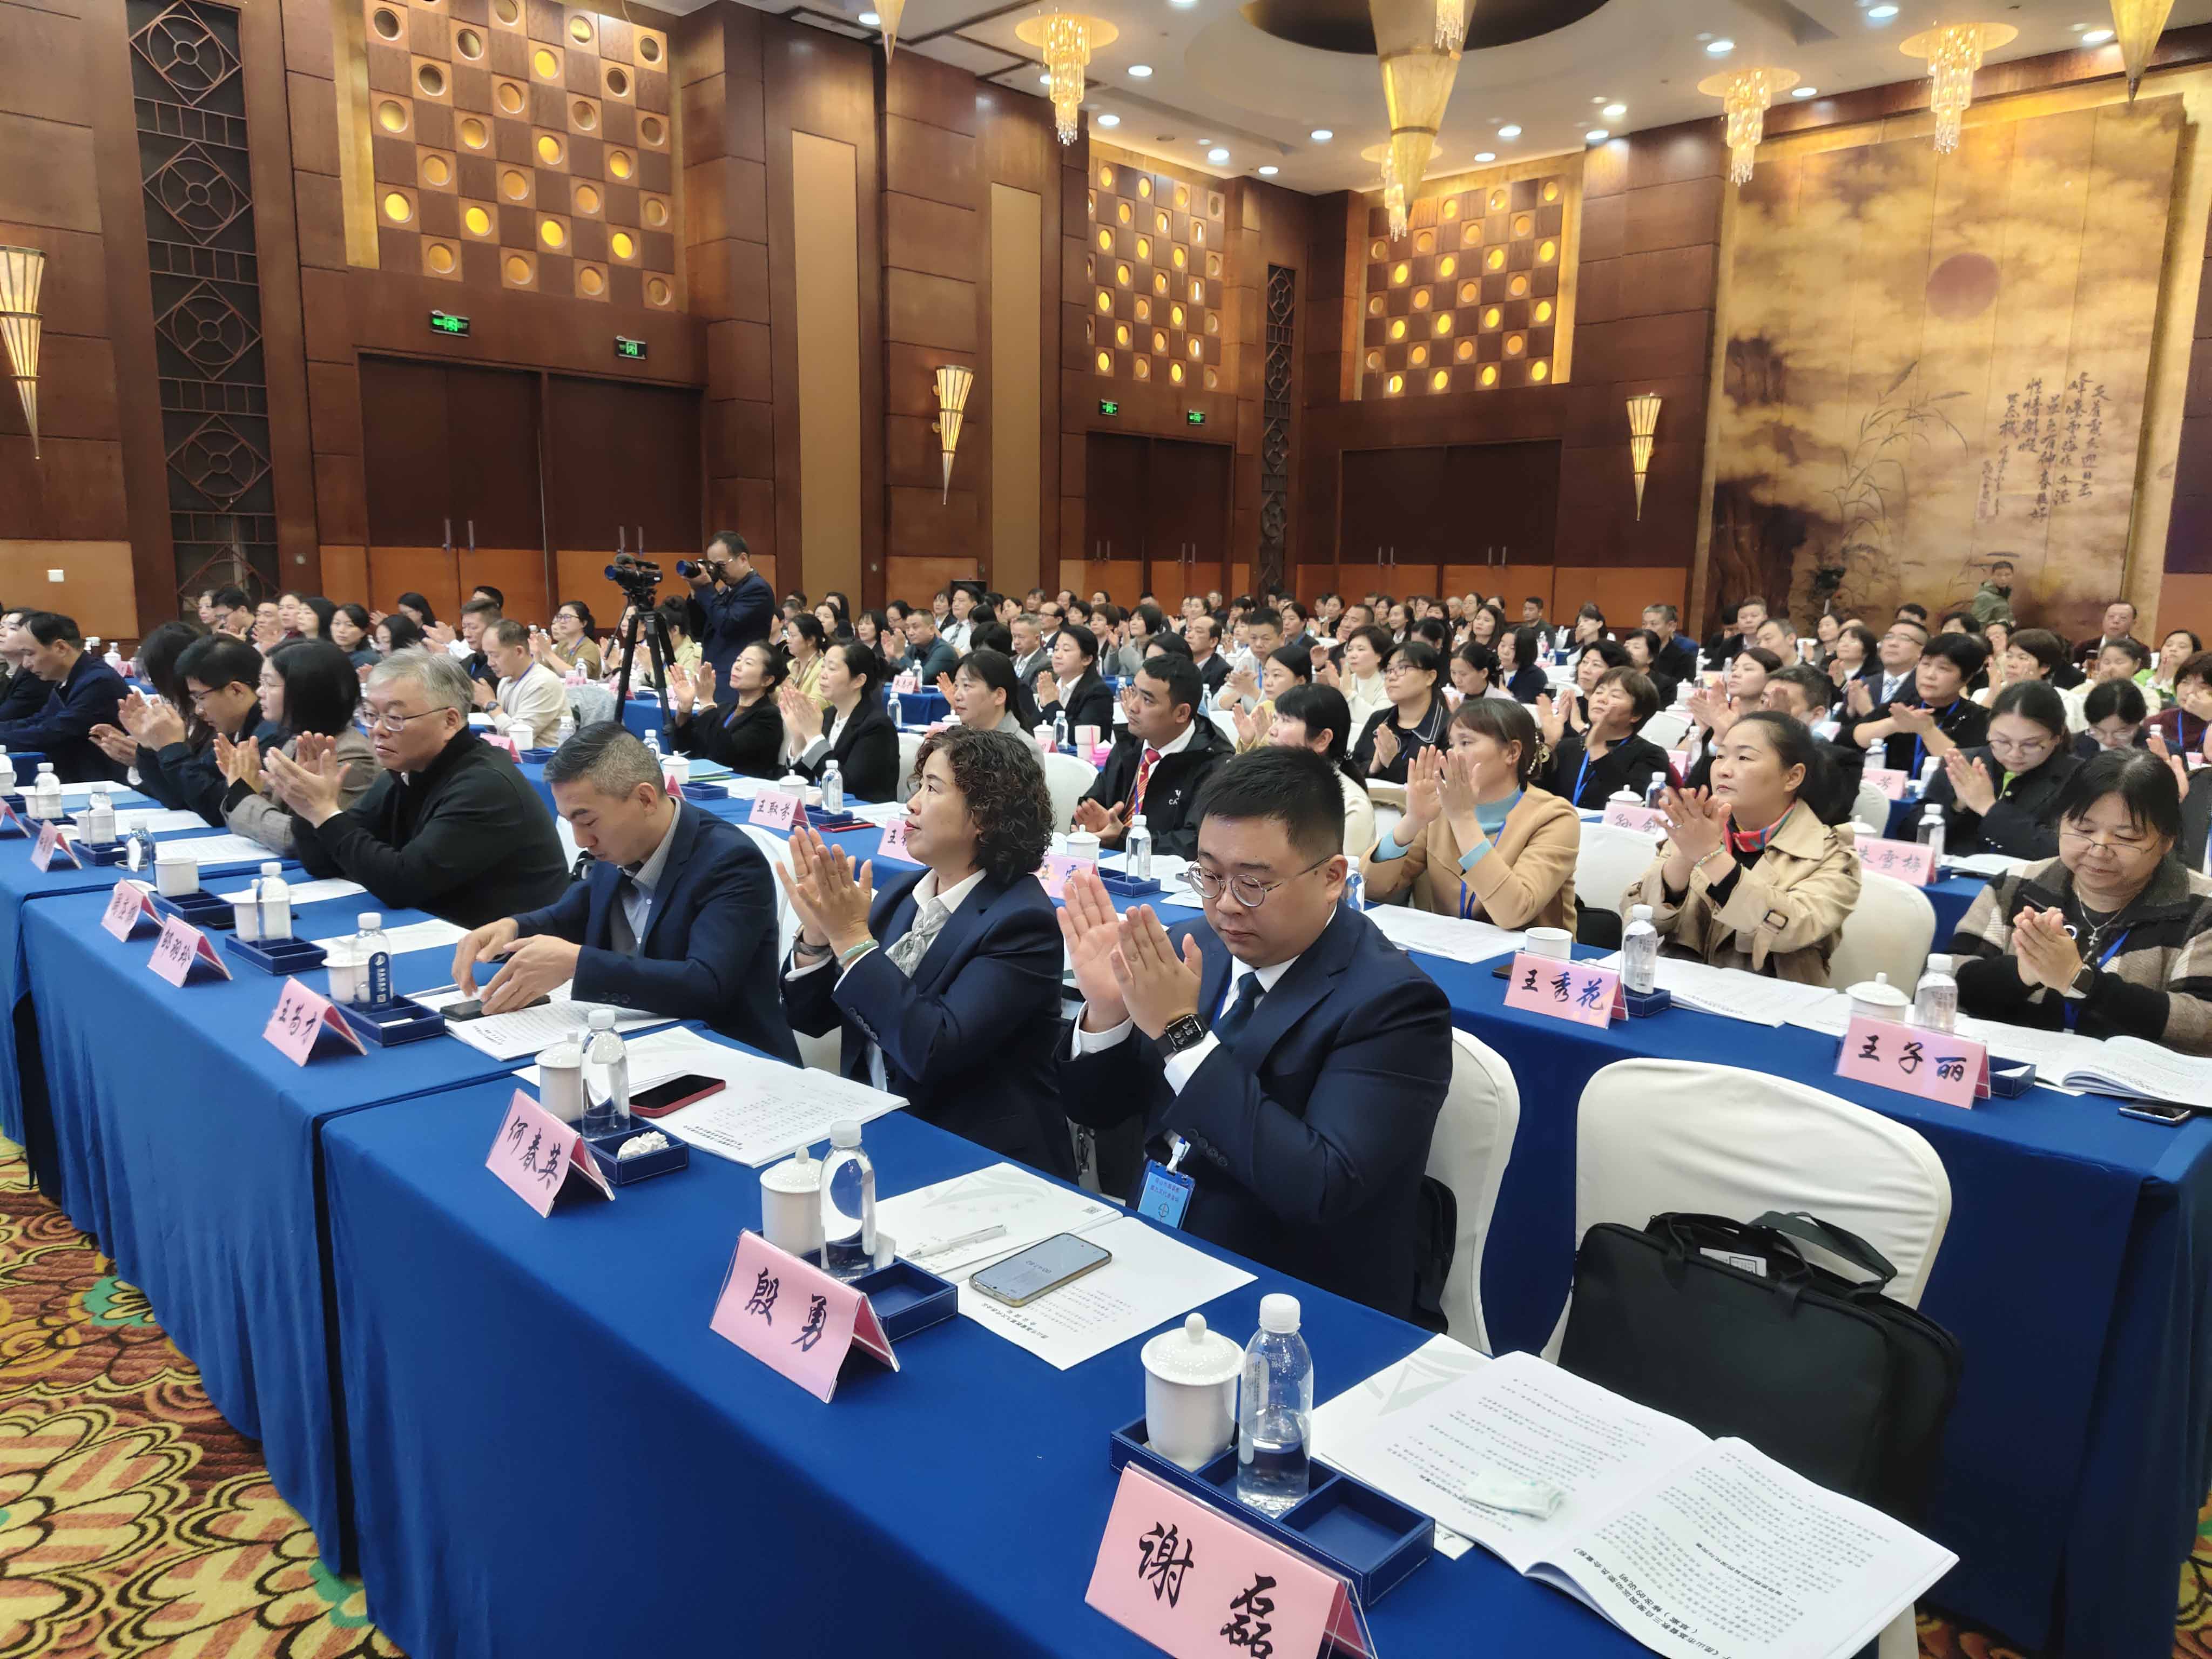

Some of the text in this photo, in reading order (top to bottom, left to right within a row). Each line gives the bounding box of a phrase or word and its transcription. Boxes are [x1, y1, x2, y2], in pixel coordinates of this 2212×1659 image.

[1521, 969, 1604, 1010] 王秀花
[1858, 1034, 1967, 1082] 王子丽
[507, 1115, 562, 1190] 何春英
[744, 1266, 827, 1353] 殷勇
[1138, 1520, 1279, 1659] 谢磊
